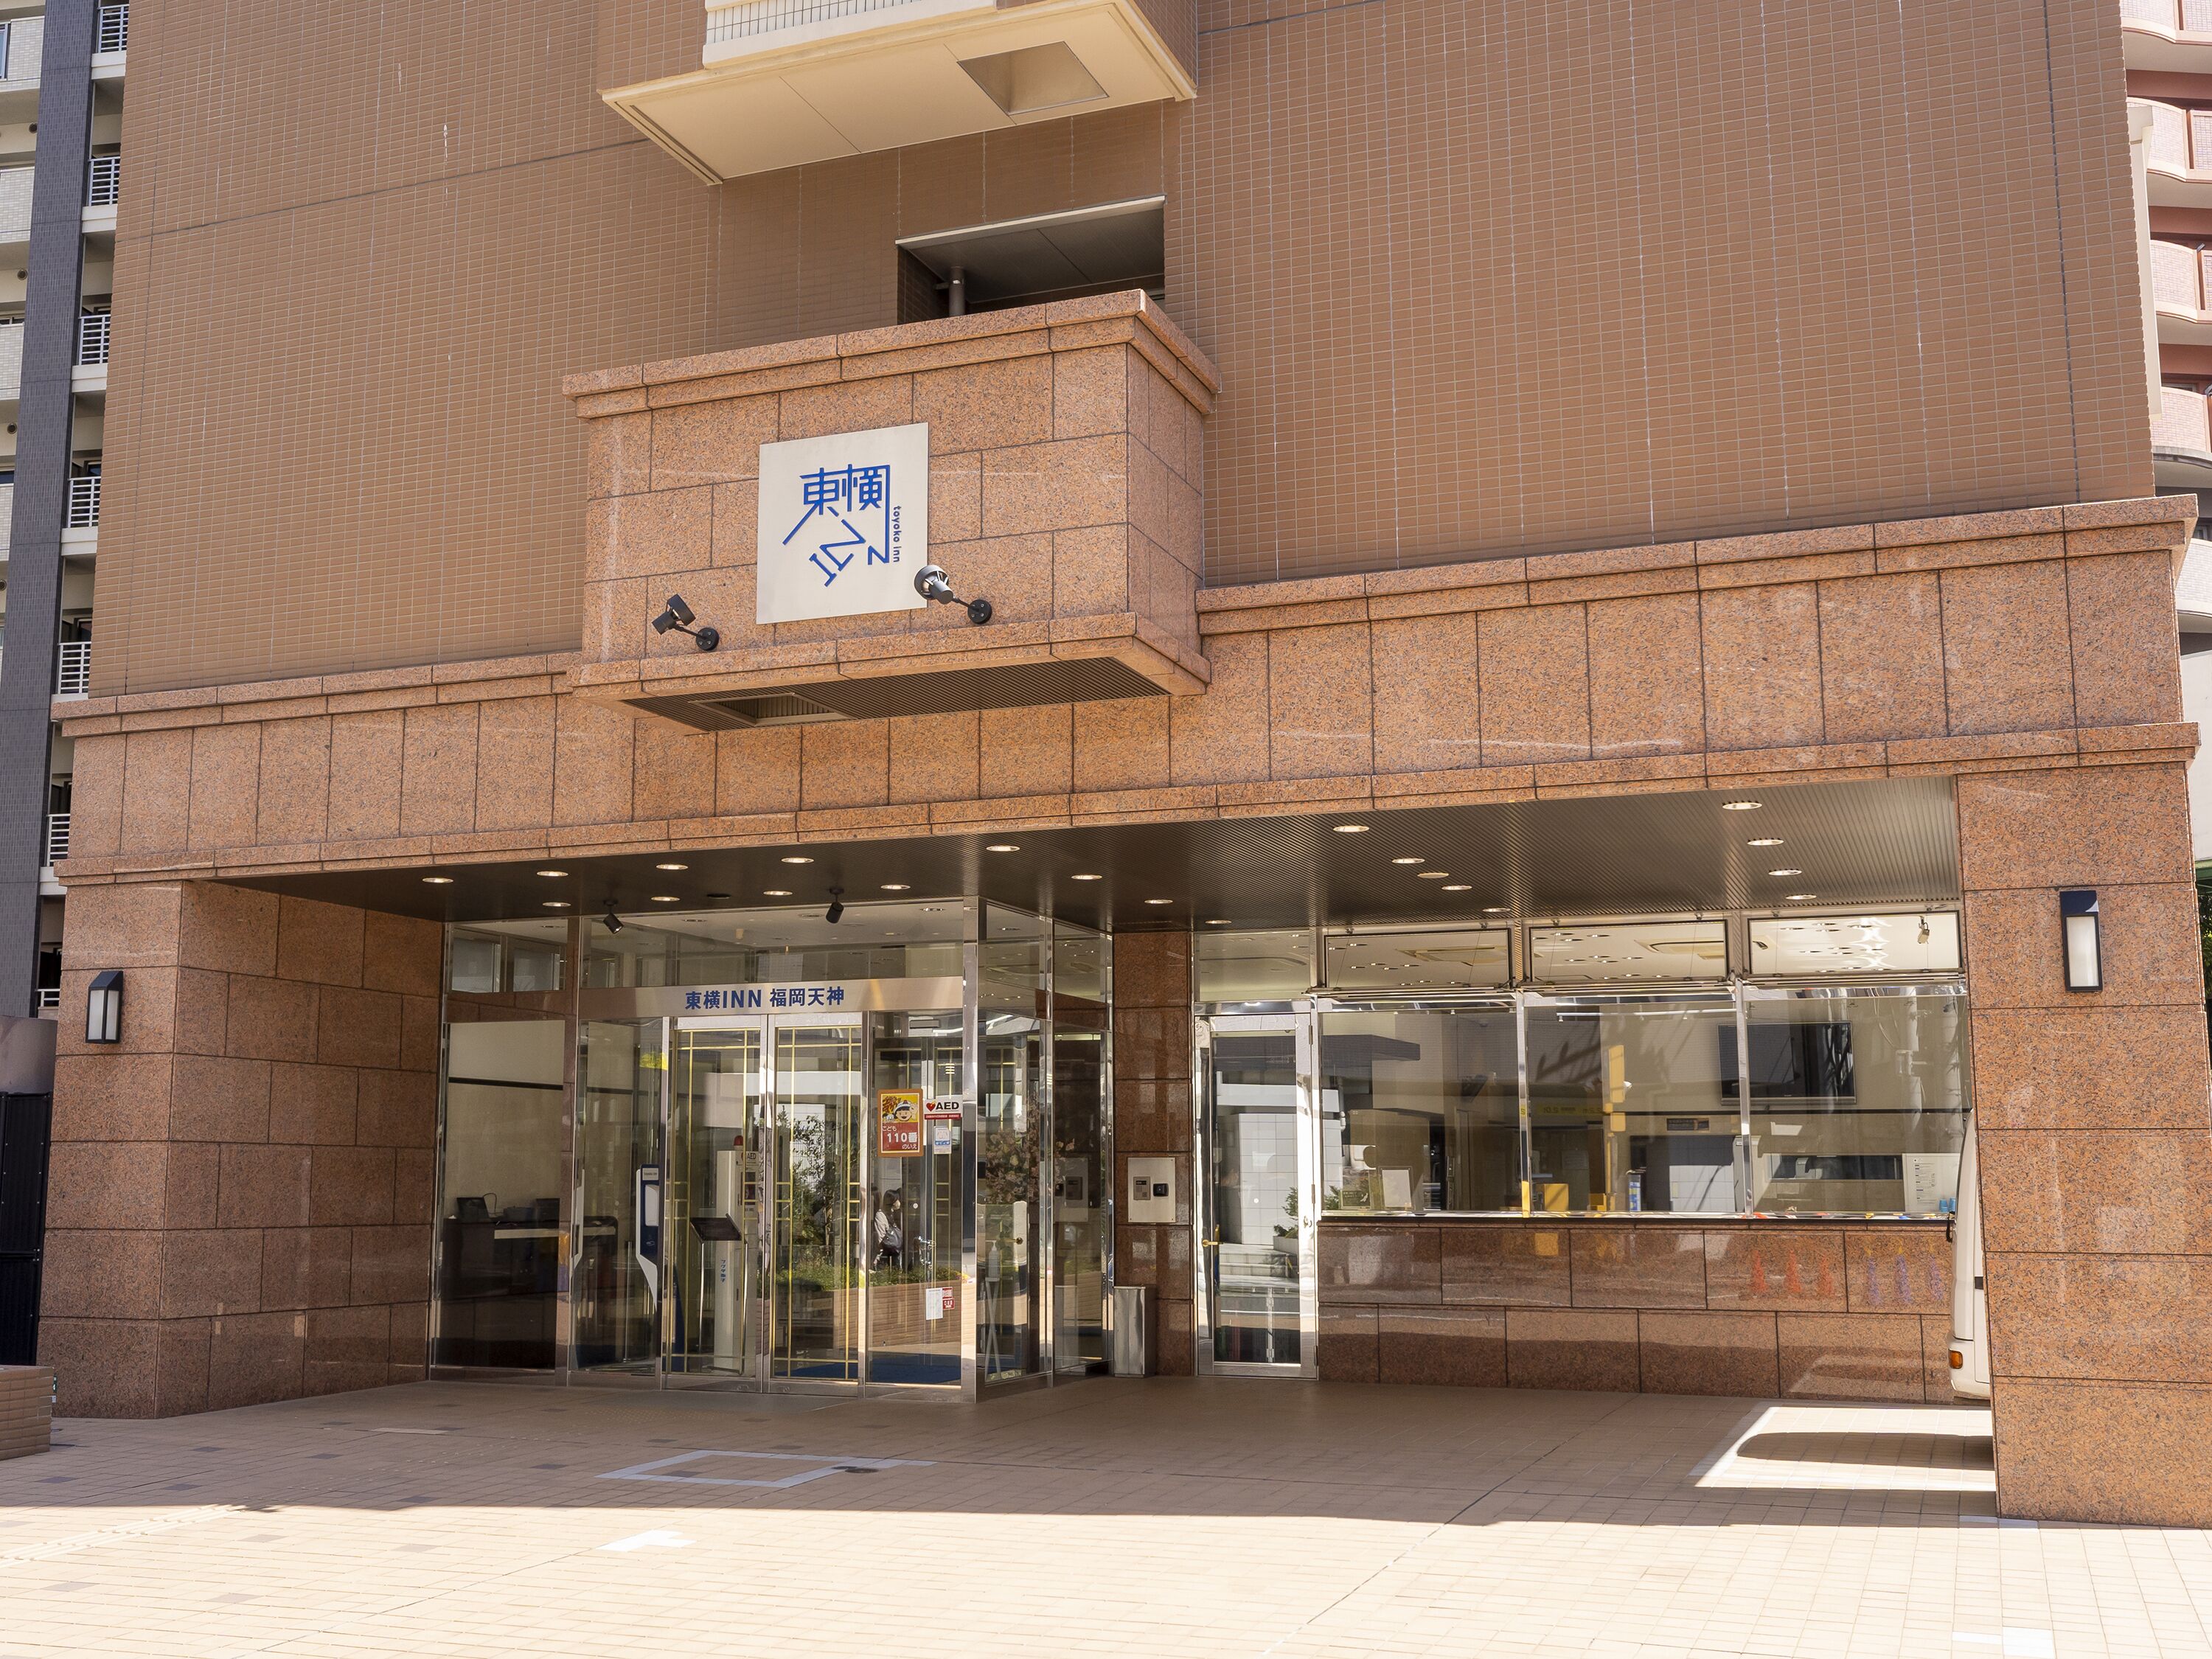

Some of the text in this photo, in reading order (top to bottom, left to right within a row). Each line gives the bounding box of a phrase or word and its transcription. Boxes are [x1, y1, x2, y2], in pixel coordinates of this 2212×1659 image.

[891, 506, 902, 563] toyoko inn
[685, 986, 844, 1009] 東横INN 福岡天神
[935, 1102, 959, 1110] AED
[887, 1132, 918, 1143] 110番
[747, 1152, 757, 1160] AED
